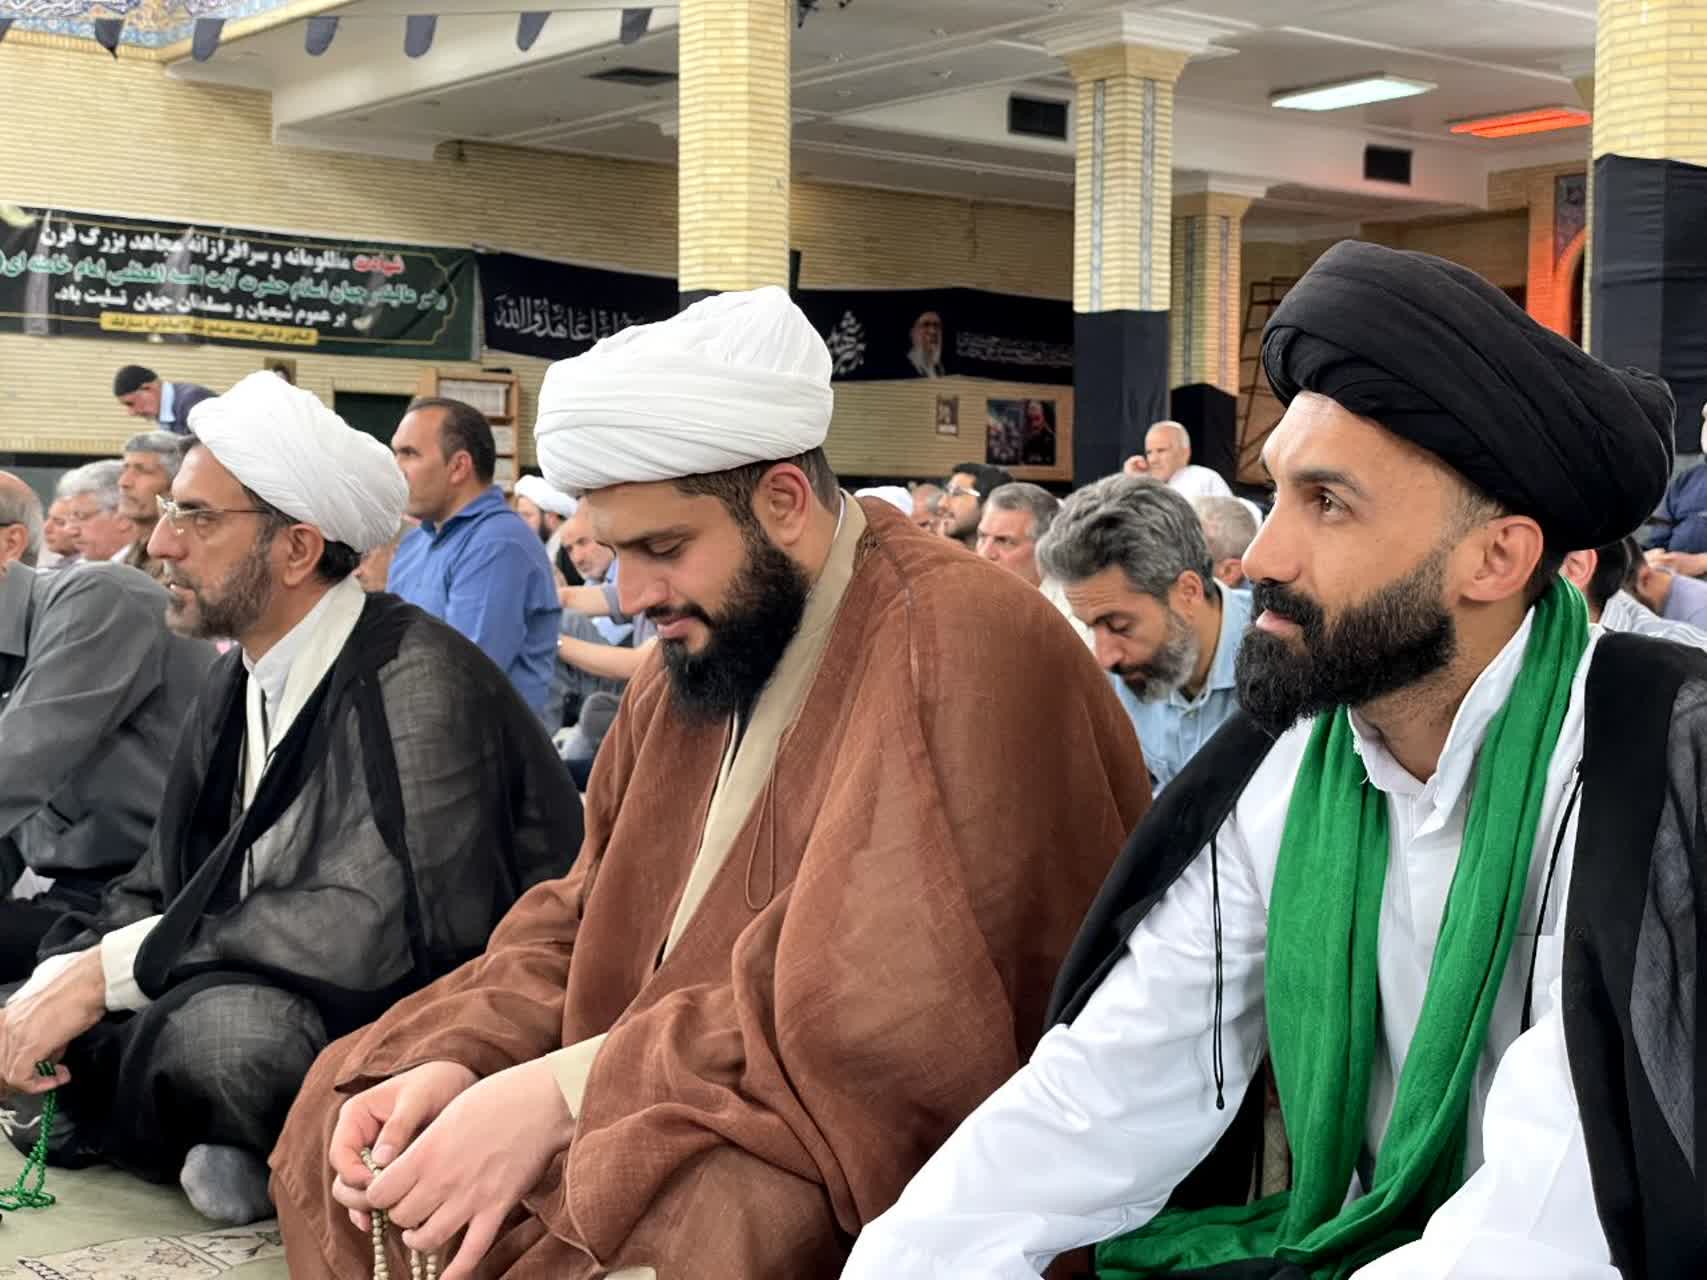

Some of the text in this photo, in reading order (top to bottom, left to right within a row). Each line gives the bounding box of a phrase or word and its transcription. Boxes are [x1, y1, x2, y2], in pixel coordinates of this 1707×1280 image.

[39, 221, 77, 248] قرن
[78, 226, 127, 254] بزرگ
[129, 232, 184, 256] مجاهد
[73, 255, 106, 282] امام
[271, 251, 282, 269] و
[284, 248, 351, 273] مظلومانه
[352, 254, 405, 276] شهادت
[83, 287, 129, 307] تسلیت
[238, 274, 290, 299] حضرت
[290, 276, 329, 302] اسلام
[329, 279, 368, 305] جهان
[132, 290, 174, 312] جهان
[234, 303, 245, 319] و
[246, 301, 293, 321] شیعیان
[295, 309, 331, 326] عموم
[331, 311, 347, 327] بر
